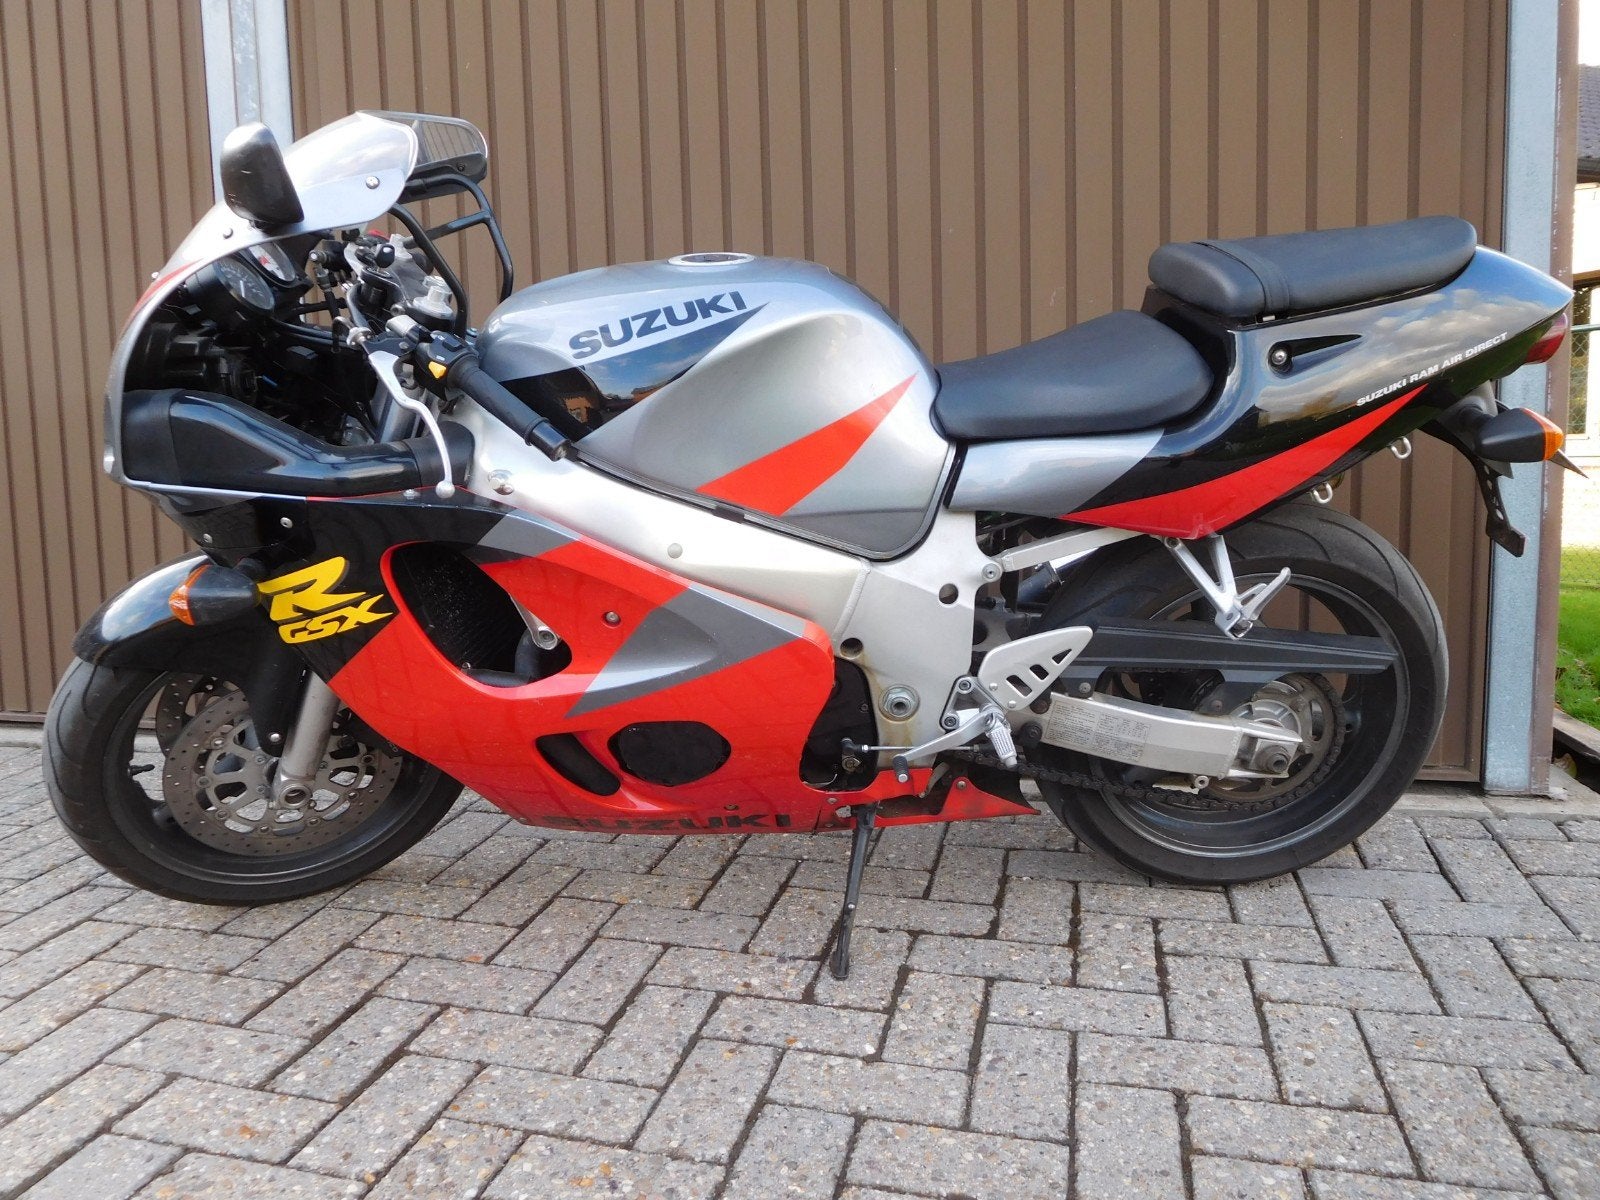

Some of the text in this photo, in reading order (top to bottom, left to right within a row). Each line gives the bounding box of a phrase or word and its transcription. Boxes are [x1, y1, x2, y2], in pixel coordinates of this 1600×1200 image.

[569, 291, 747, 360] SUZUKI
[1356, 331, 1508, 407] SUZUKI RAM AIR DIRECT
[257, 556, 367, 621] R
[278, 594, 394, 644] GSX
